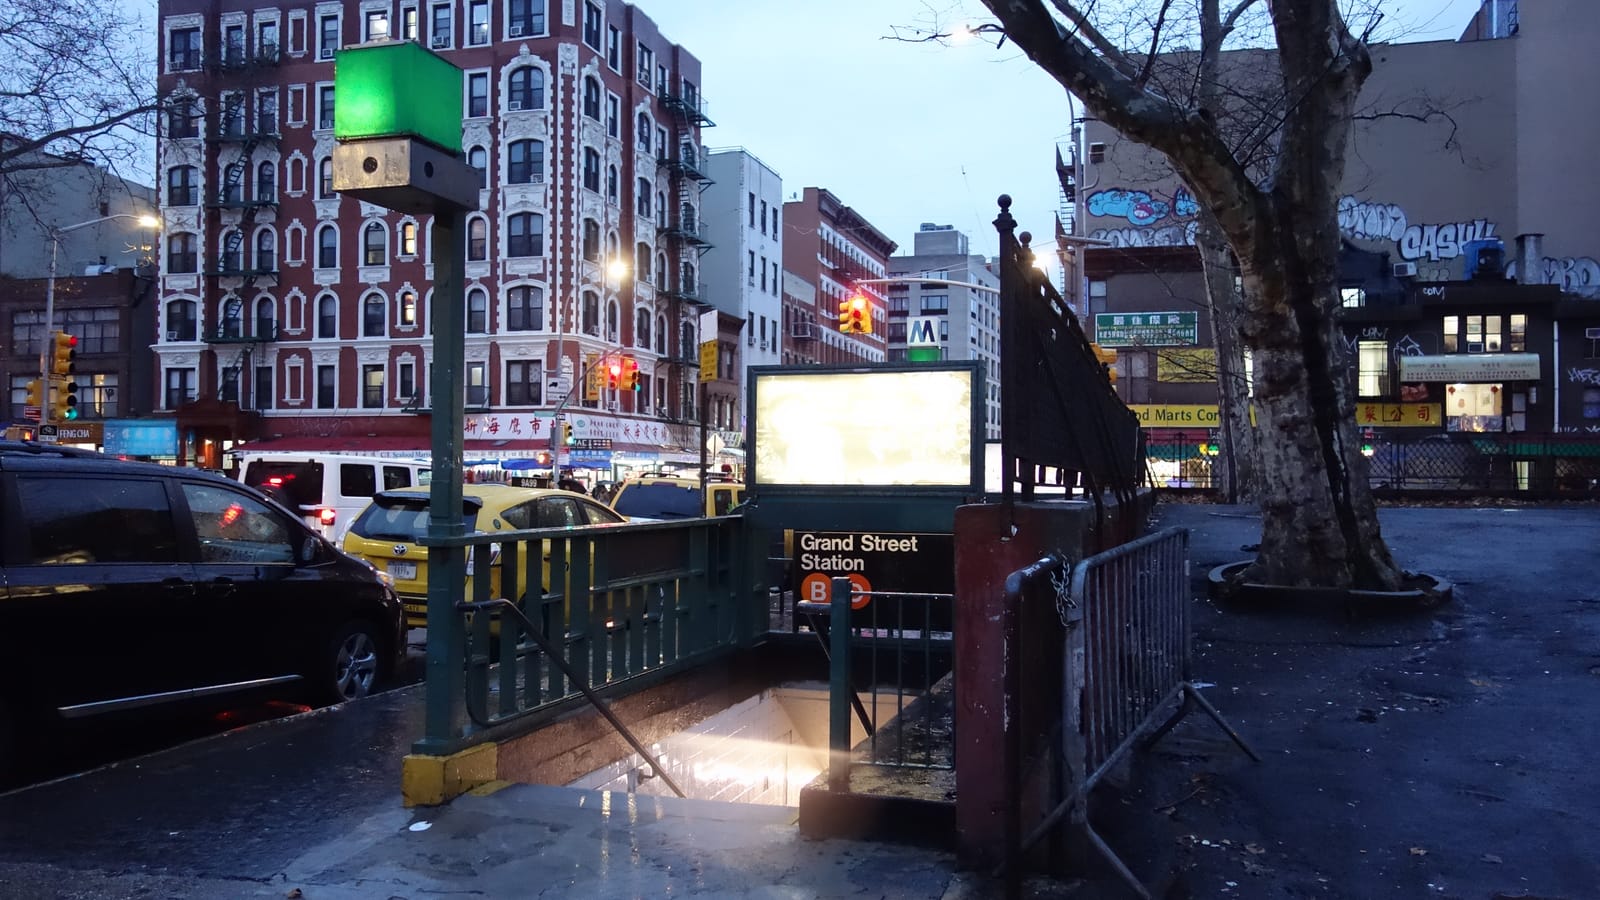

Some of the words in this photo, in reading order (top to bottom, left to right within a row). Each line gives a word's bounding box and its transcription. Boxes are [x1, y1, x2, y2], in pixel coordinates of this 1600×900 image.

[909, 320, 935, 343] M
[1156, 409, 1192, 421] Marts
[59, 429, 77, 438] FENG
[77, 429, 90, 438] CHA
[800, 533, 853, 551] Grand
[861, 534, 918, 552] Street
[800, 553, 865, 571] Station
[811, 581, 827, 601] B
